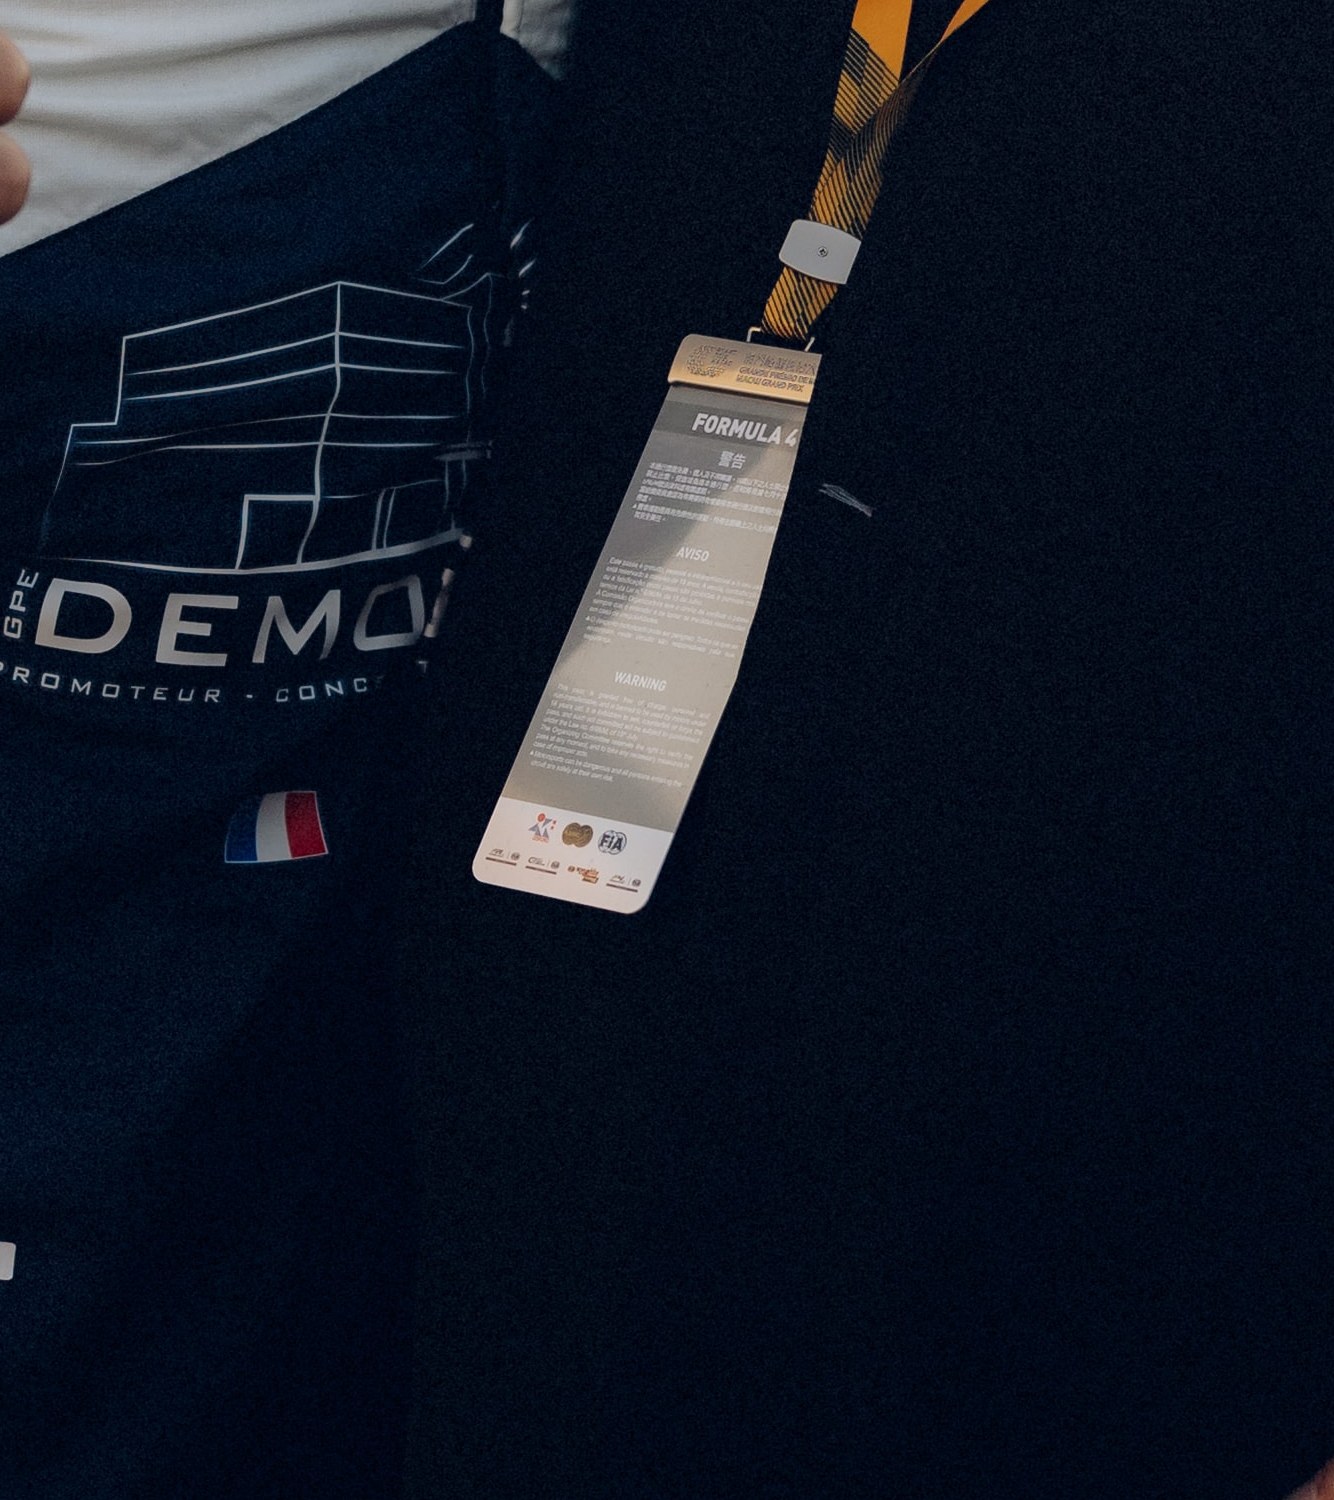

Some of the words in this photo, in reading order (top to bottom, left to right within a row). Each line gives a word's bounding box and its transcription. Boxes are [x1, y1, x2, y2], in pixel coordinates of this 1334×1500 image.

[691, 412, 782, 445] FORMULA
[784, 428, 800, 447] 4
[718, 450, 747, 470] 警告
[675, 546, 709, 562] AVISO
[3, 568, 39, 640] GPE
[613, 671, 667, 692] WARNING
[599, 832, 625, 852] FIA
